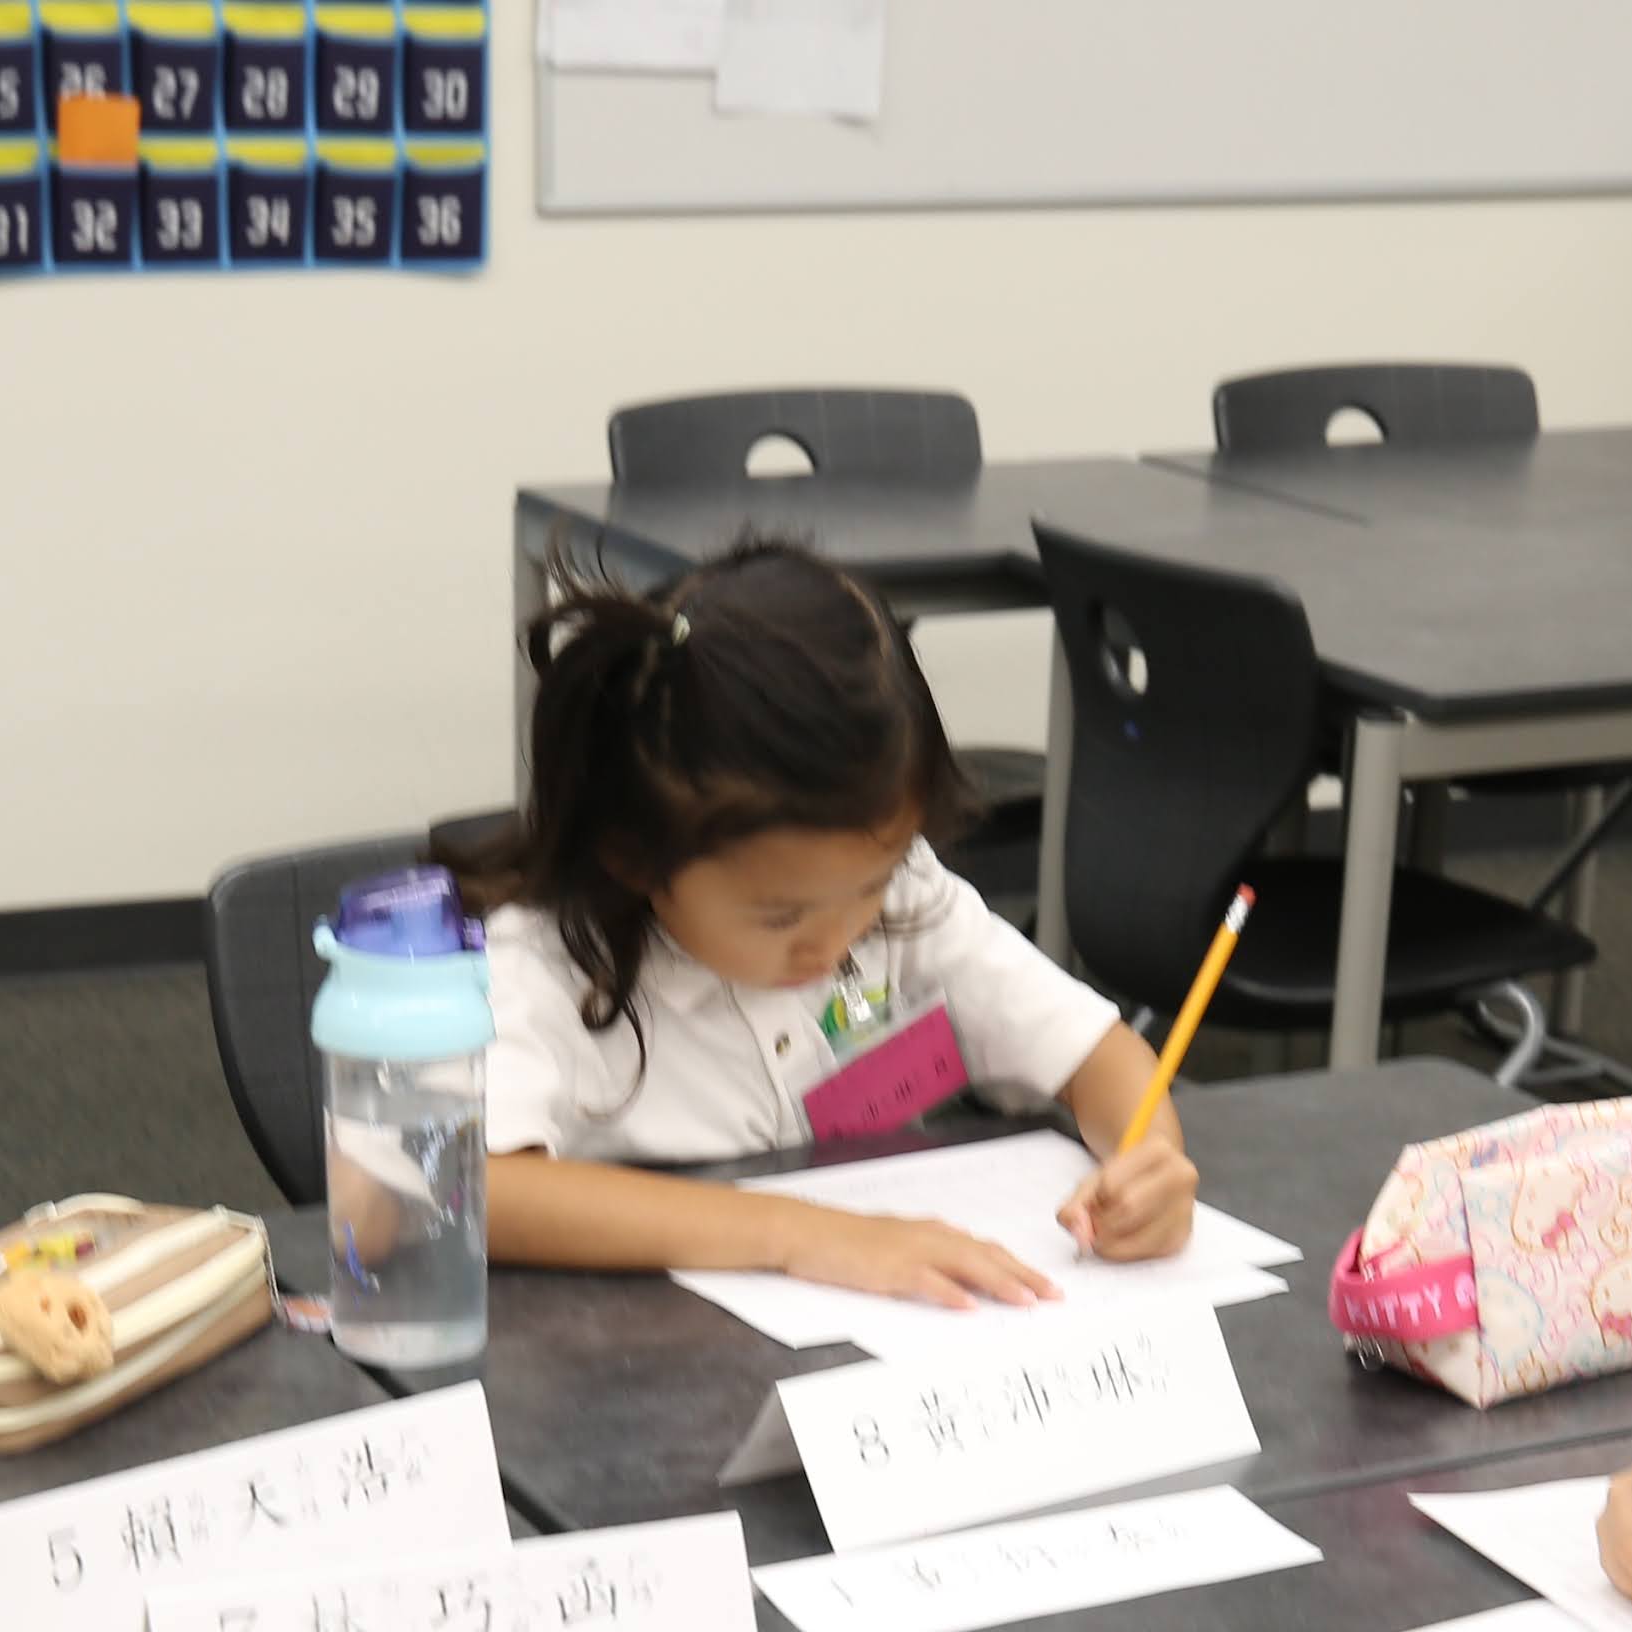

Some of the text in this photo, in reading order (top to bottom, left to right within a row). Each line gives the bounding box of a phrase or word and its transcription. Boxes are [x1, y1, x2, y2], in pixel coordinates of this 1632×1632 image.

[153, 66, 199, 121] 27
[242, 66, 289, 121] 28
[333, 66, 379, 121] 29
[424, 67, 470, 121] 30
[72, 200, 118, 253] 32
[157, 198, 203, 250] 33
[247, 195, 291, 248] 34
[331, 195, 377, 248] 35
[418, 195, 463, 247] 36
[1343, 1282, 1443, 1329] KITTY
[852, 1413, 890, 1468] 8
[48, 1527, 84, 1591] 5
